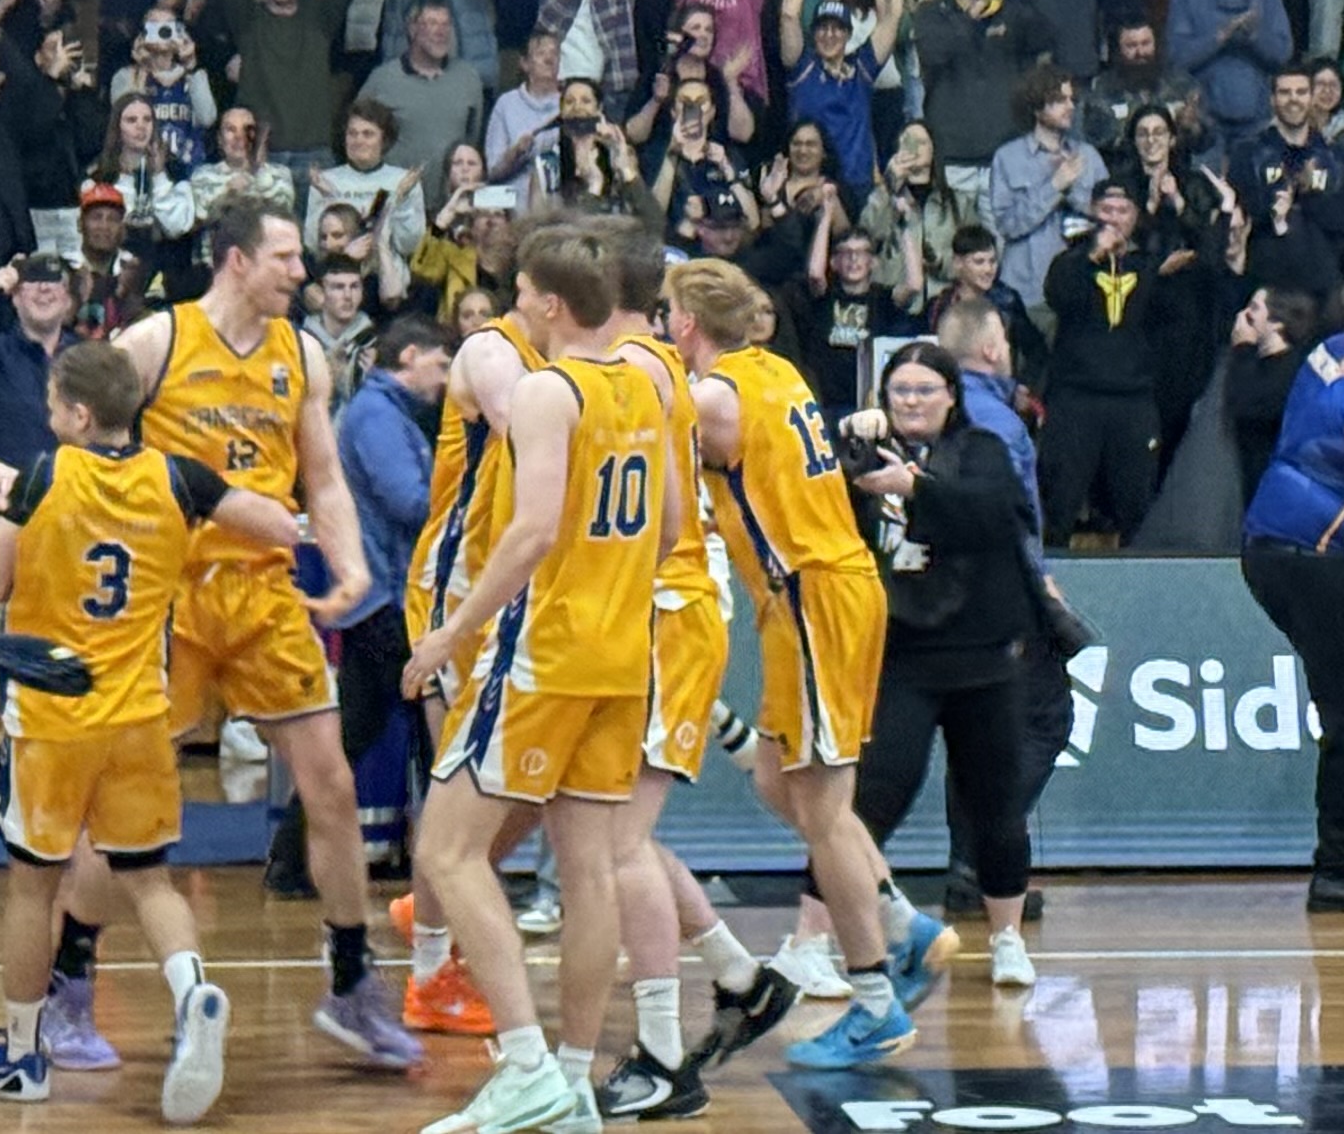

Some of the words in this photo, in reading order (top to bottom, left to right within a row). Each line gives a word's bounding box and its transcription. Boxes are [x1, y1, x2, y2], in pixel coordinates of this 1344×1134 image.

[788, 399, 841, 479] 13
[588, 453, 650, 538] 10
[82, 541, 132, 620] 3
[840, 1097, 1304, 1132] Foot
